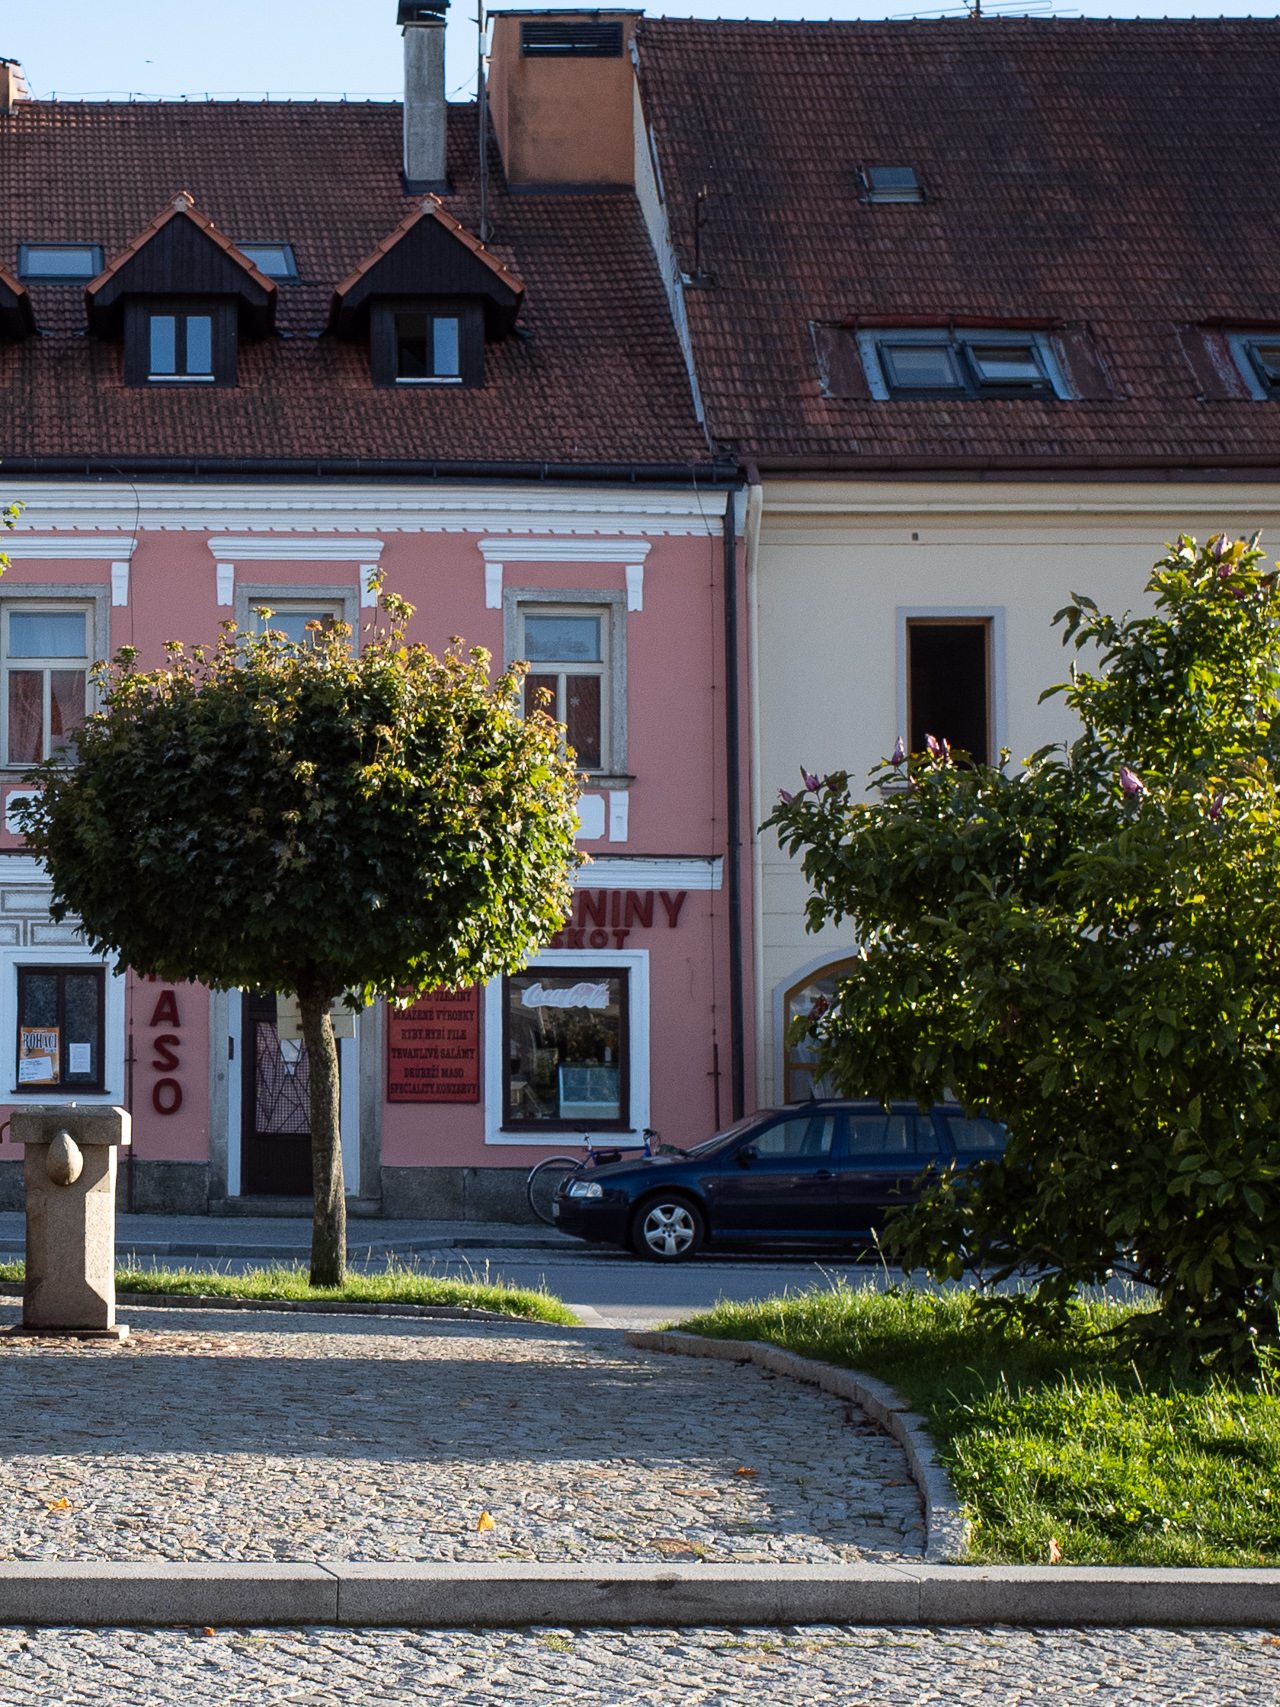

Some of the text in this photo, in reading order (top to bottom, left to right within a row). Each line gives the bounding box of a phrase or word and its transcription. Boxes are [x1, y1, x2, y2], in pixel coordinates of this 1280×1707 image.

[565, 890, 687, 929] NINY
[148, 974, 183, 1115] ASO
[441, 1067, 464, 1078] MASO
